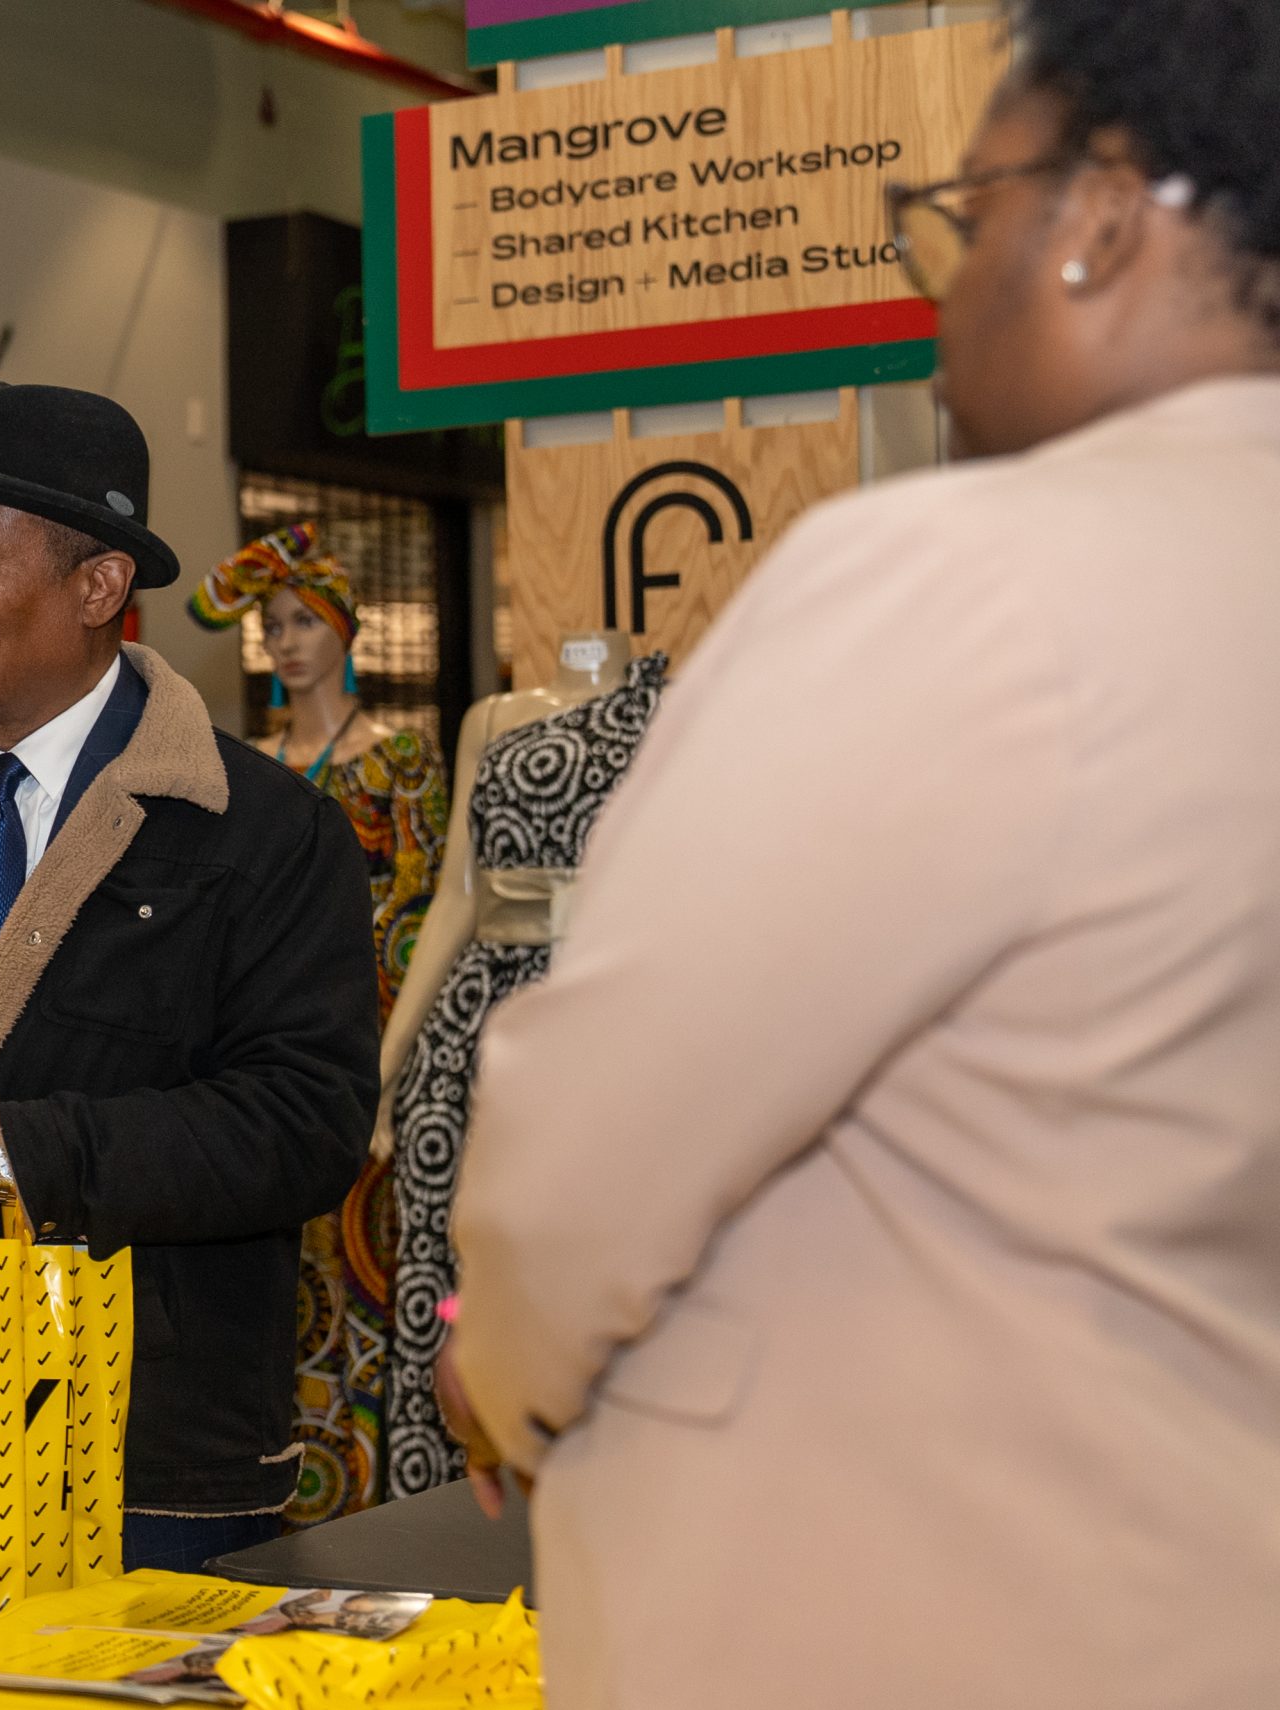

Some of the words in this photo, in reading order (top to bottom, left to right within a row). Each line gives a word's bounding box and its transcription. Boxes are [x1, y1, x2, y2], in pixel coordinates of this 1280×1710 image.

[450, 107, 727, 170] Mangrove
[490, 170, 678, 213] Bodycare
[689, 140, 902, 187] Workshop
[491, 219, 632, 260] Shared
[642, 204, 799, 243] Kitchen
[491, 274, 625, 309] Design
[669, 252, 789, 289] Media
